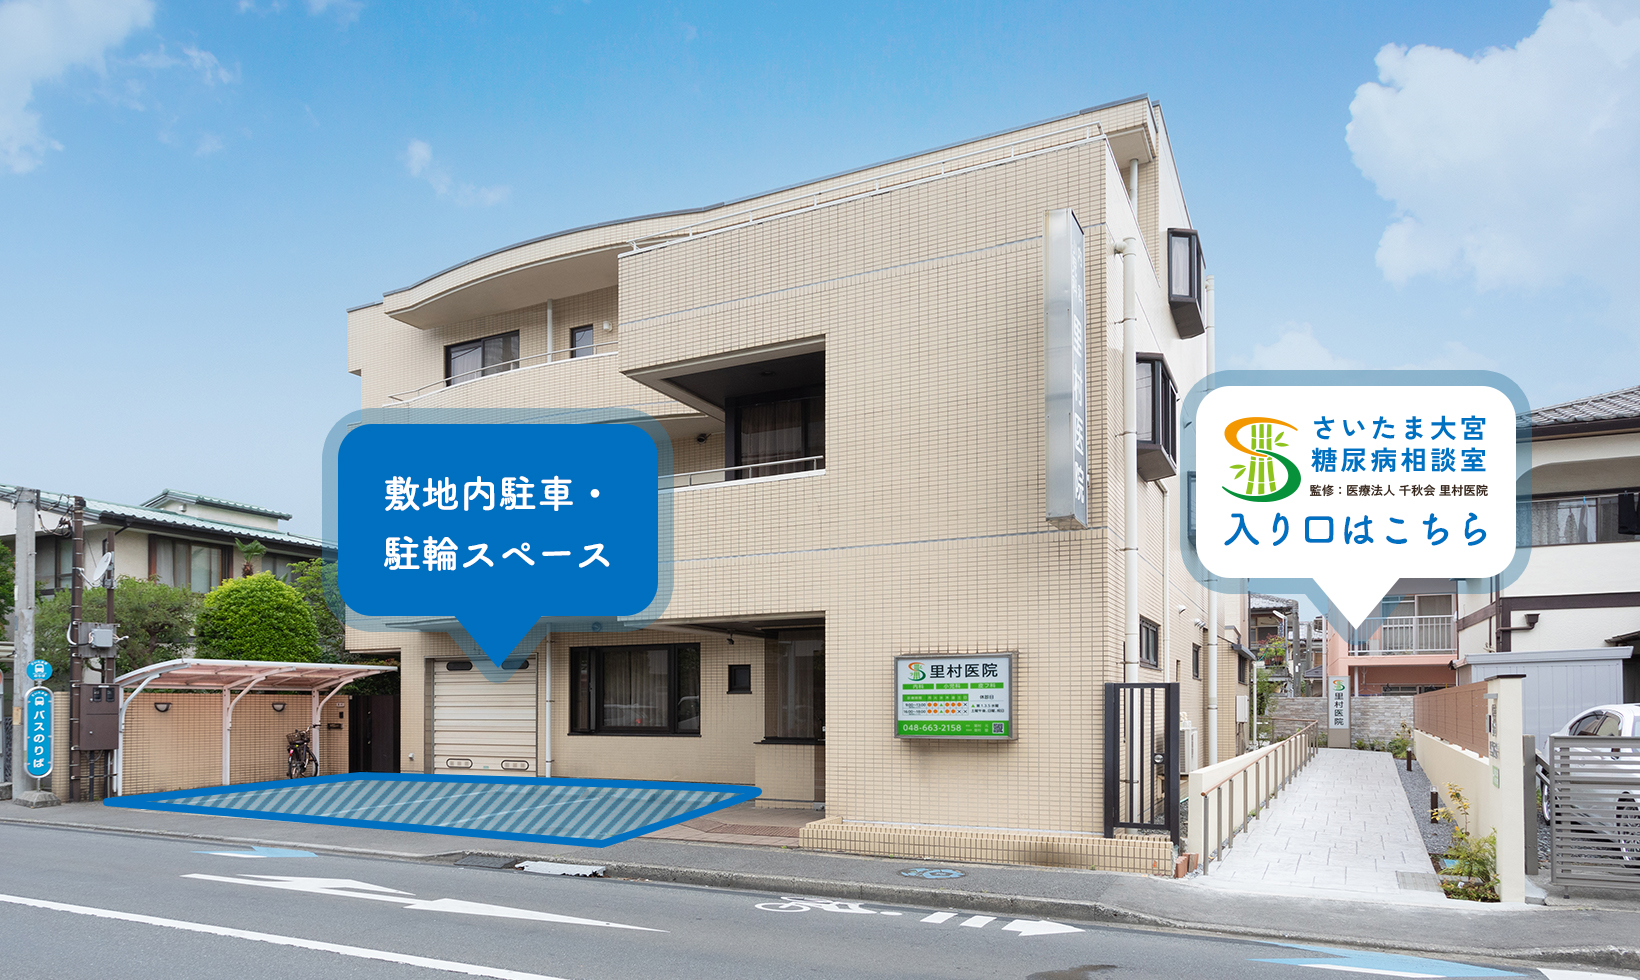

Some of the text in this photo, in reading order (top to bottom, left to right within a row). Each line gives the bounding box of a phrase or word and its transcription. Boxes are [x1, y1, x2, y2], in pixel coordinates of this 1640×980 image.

[1073, 312, 1085, 505] 里村医院
[930, 663, 998, 679] 里村医院
[1334, 691, 1344, 726] 里村医院
[33, 710, 45, 768] バスのりば
[902, 723, 962, 732] 048-663-2158
